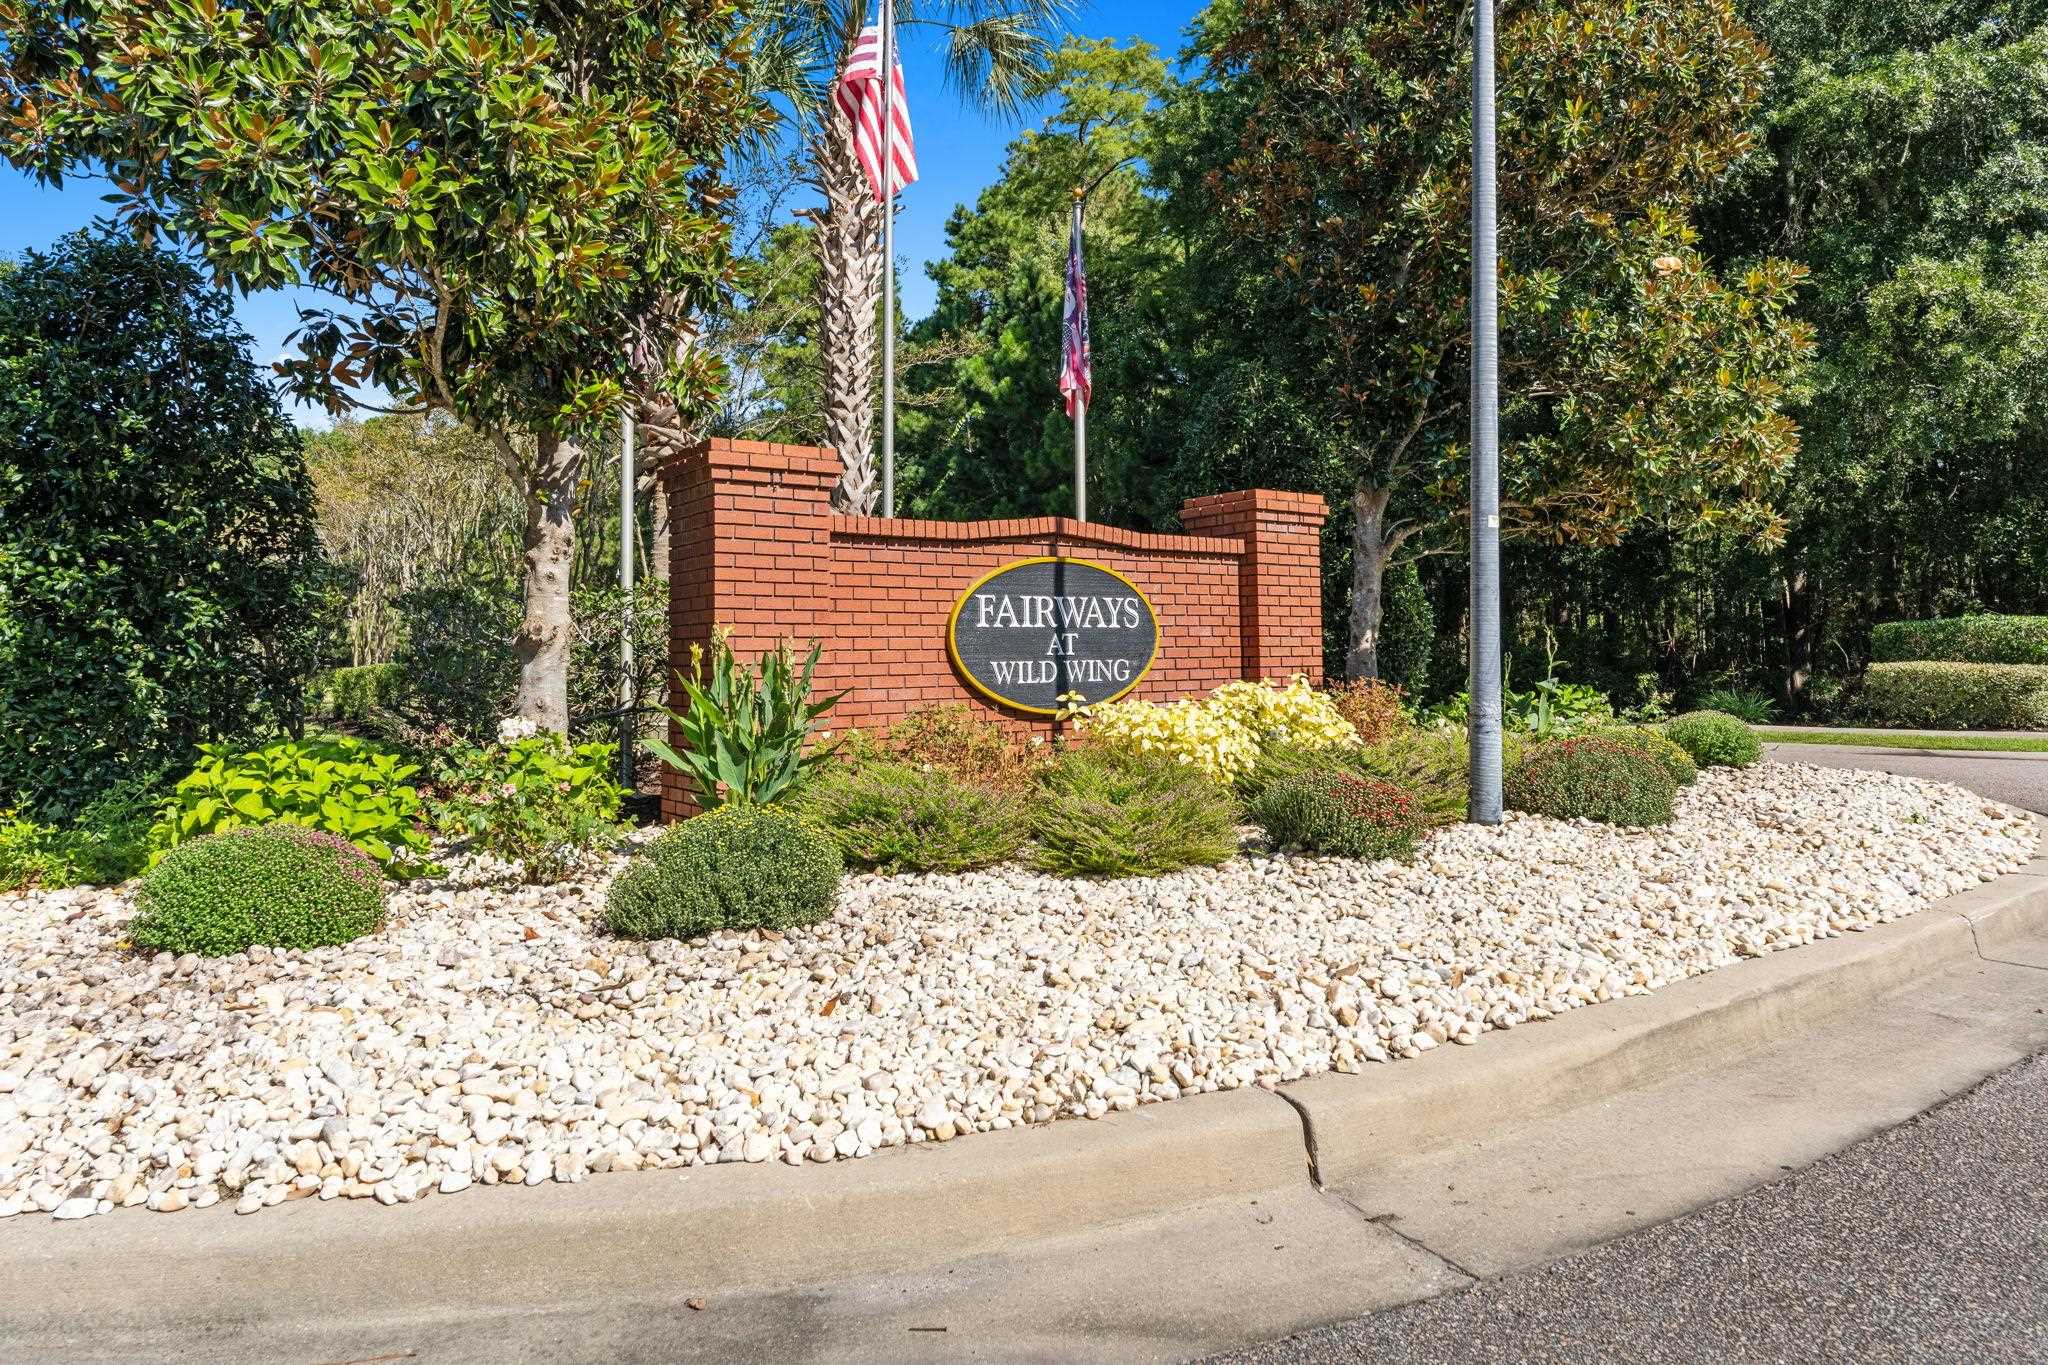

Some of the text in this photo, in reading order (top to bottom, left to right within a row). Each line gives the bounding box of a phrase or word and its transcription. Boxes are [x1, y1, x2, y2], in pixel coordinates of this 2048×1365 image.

[975, 594, 1140, 629] FAIRWAYS
[1046, 633, 1079, 656] AT
[990, 659, 1130, 685] WILD WING
